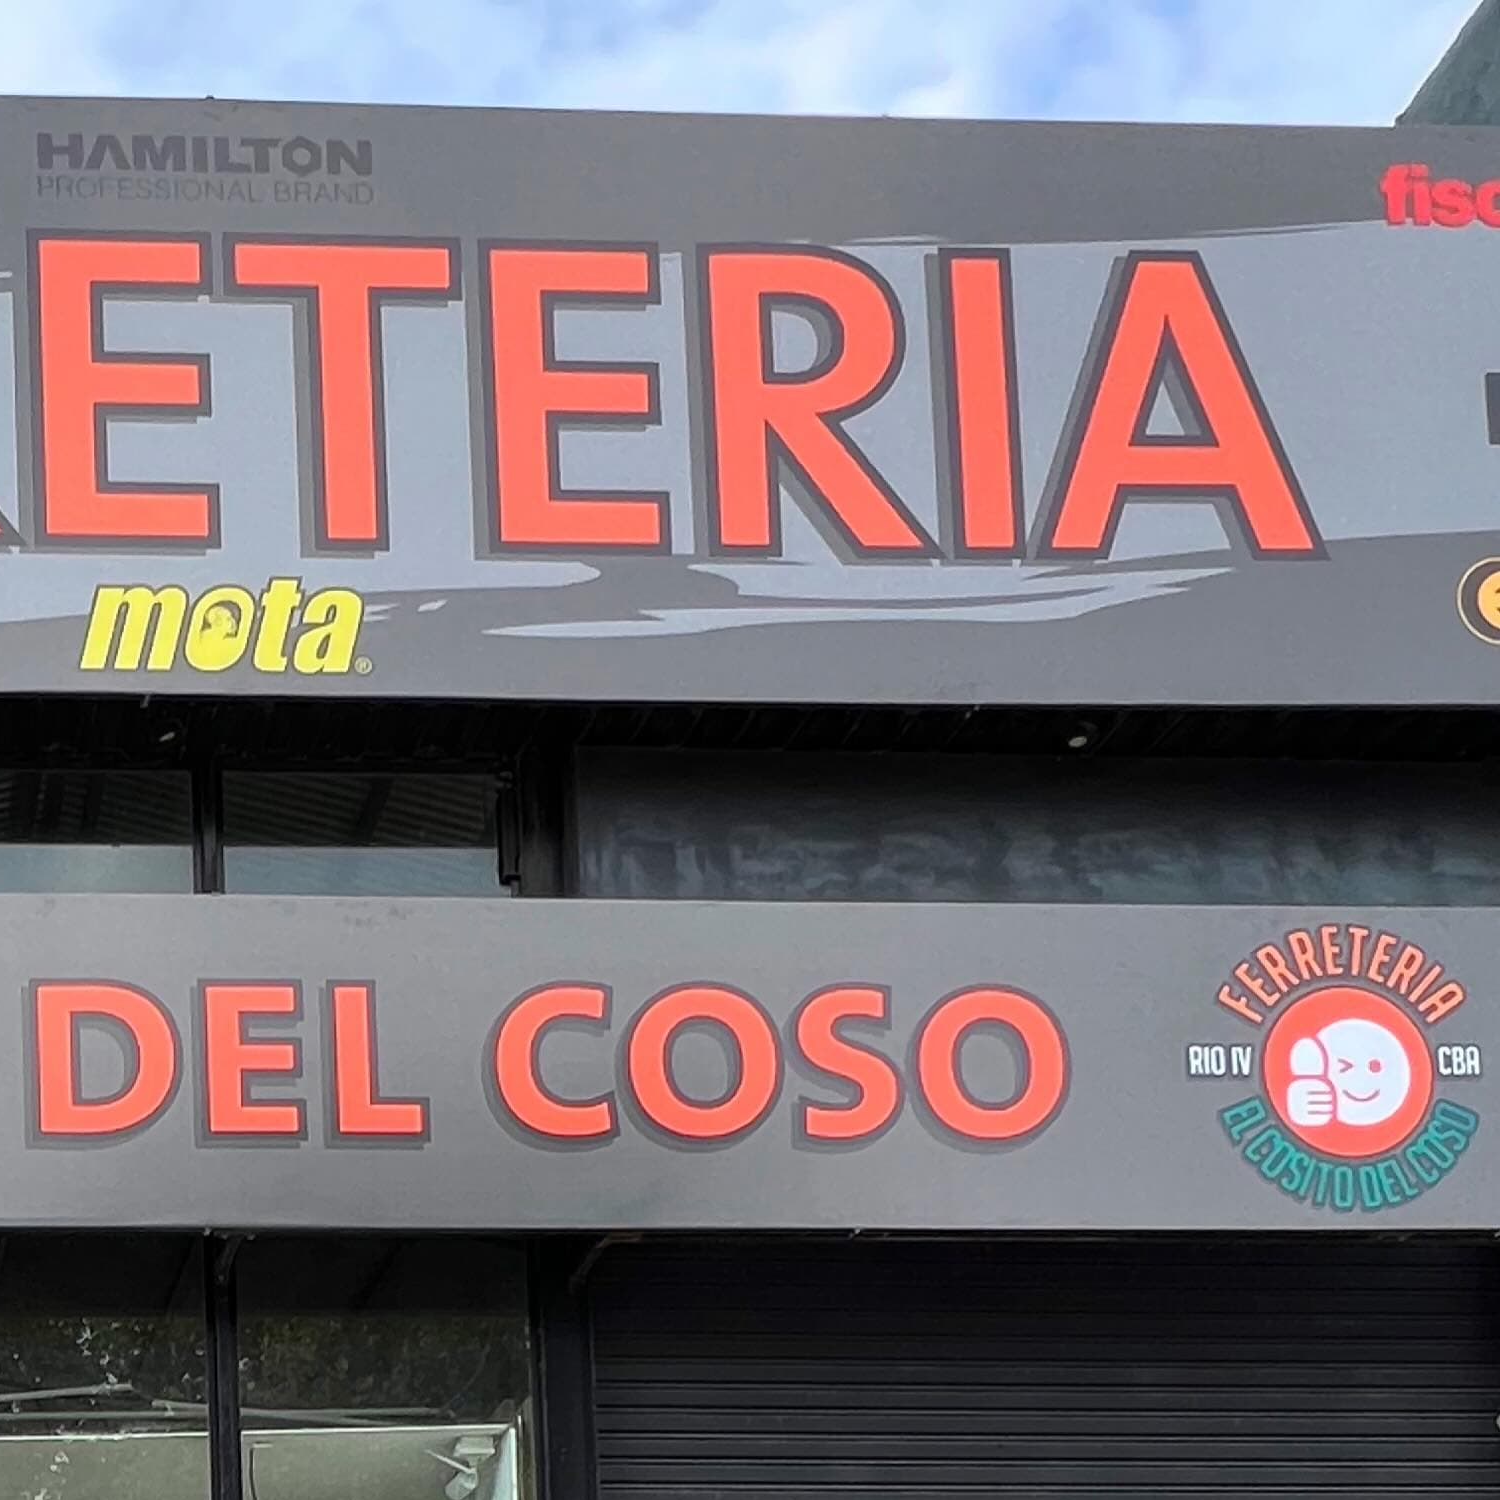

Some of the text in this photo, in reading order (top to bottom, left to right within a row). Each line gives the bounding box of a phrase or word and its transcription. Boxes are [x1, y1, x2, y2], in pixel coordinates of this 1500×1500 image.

[36, 132, 373, 176] HAMILTON
[37, 175, 375, 206] PROFESSIONAL BRAND
[78, 576, 365, 675] mota
[1218, 924, 1467, 1025] FERRETERIA
[31, 980, 428, 1141] DEL
[488, 981, 1070, 1143] COSO
[1188, 1045, 1252, 1076] RIO IV
[1437, 1046, 1480, 1076] CBA
[1221, 1097, 1479, 1208] EL COSITO DEL COSO
